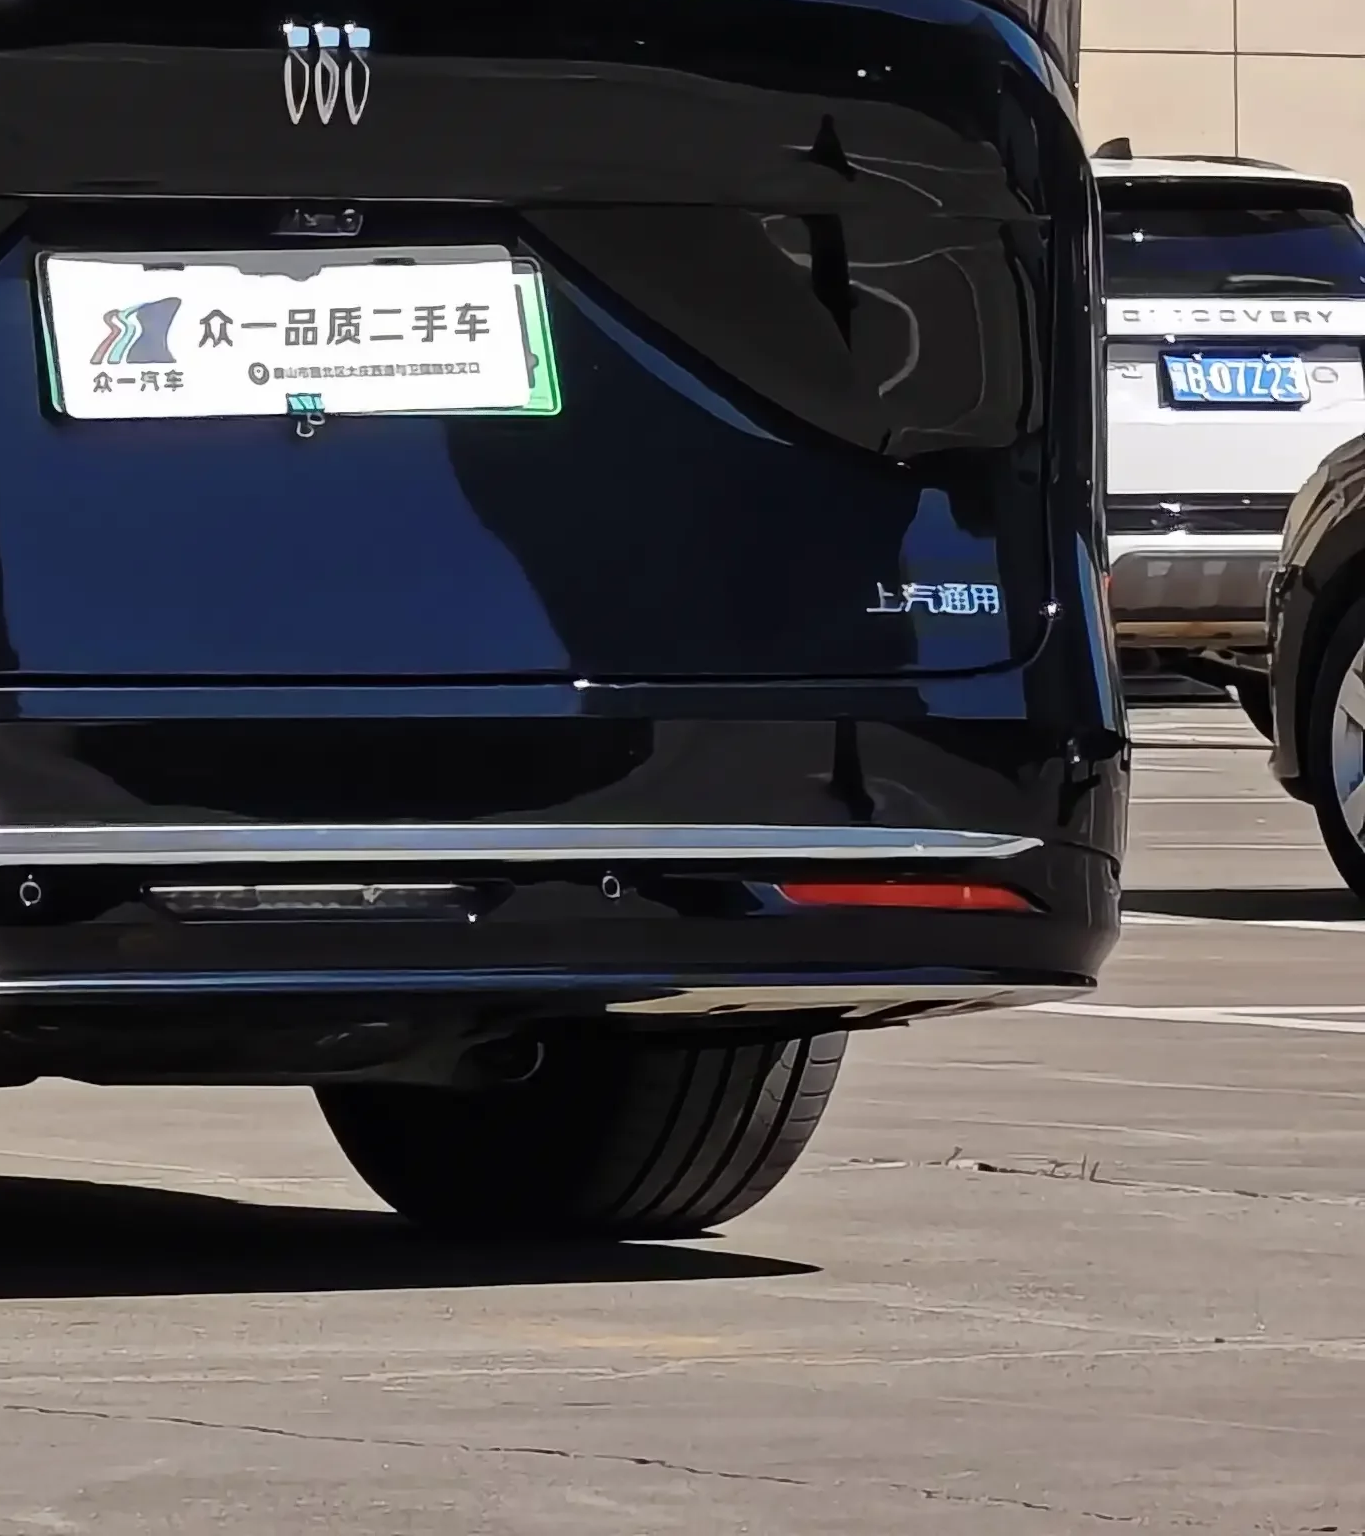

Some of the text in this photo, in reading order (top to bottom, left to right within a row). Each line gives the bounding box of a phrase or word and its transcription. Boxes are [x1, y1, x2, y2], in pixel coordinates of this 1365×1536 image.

[198, 302, 490, 348] 众一品质二手车
[1122, 309, 1333, 323] DCOVERY
[92, 369, 184, 393] 众一汽车
[866, 582, 1000, 614] 上汽通用
